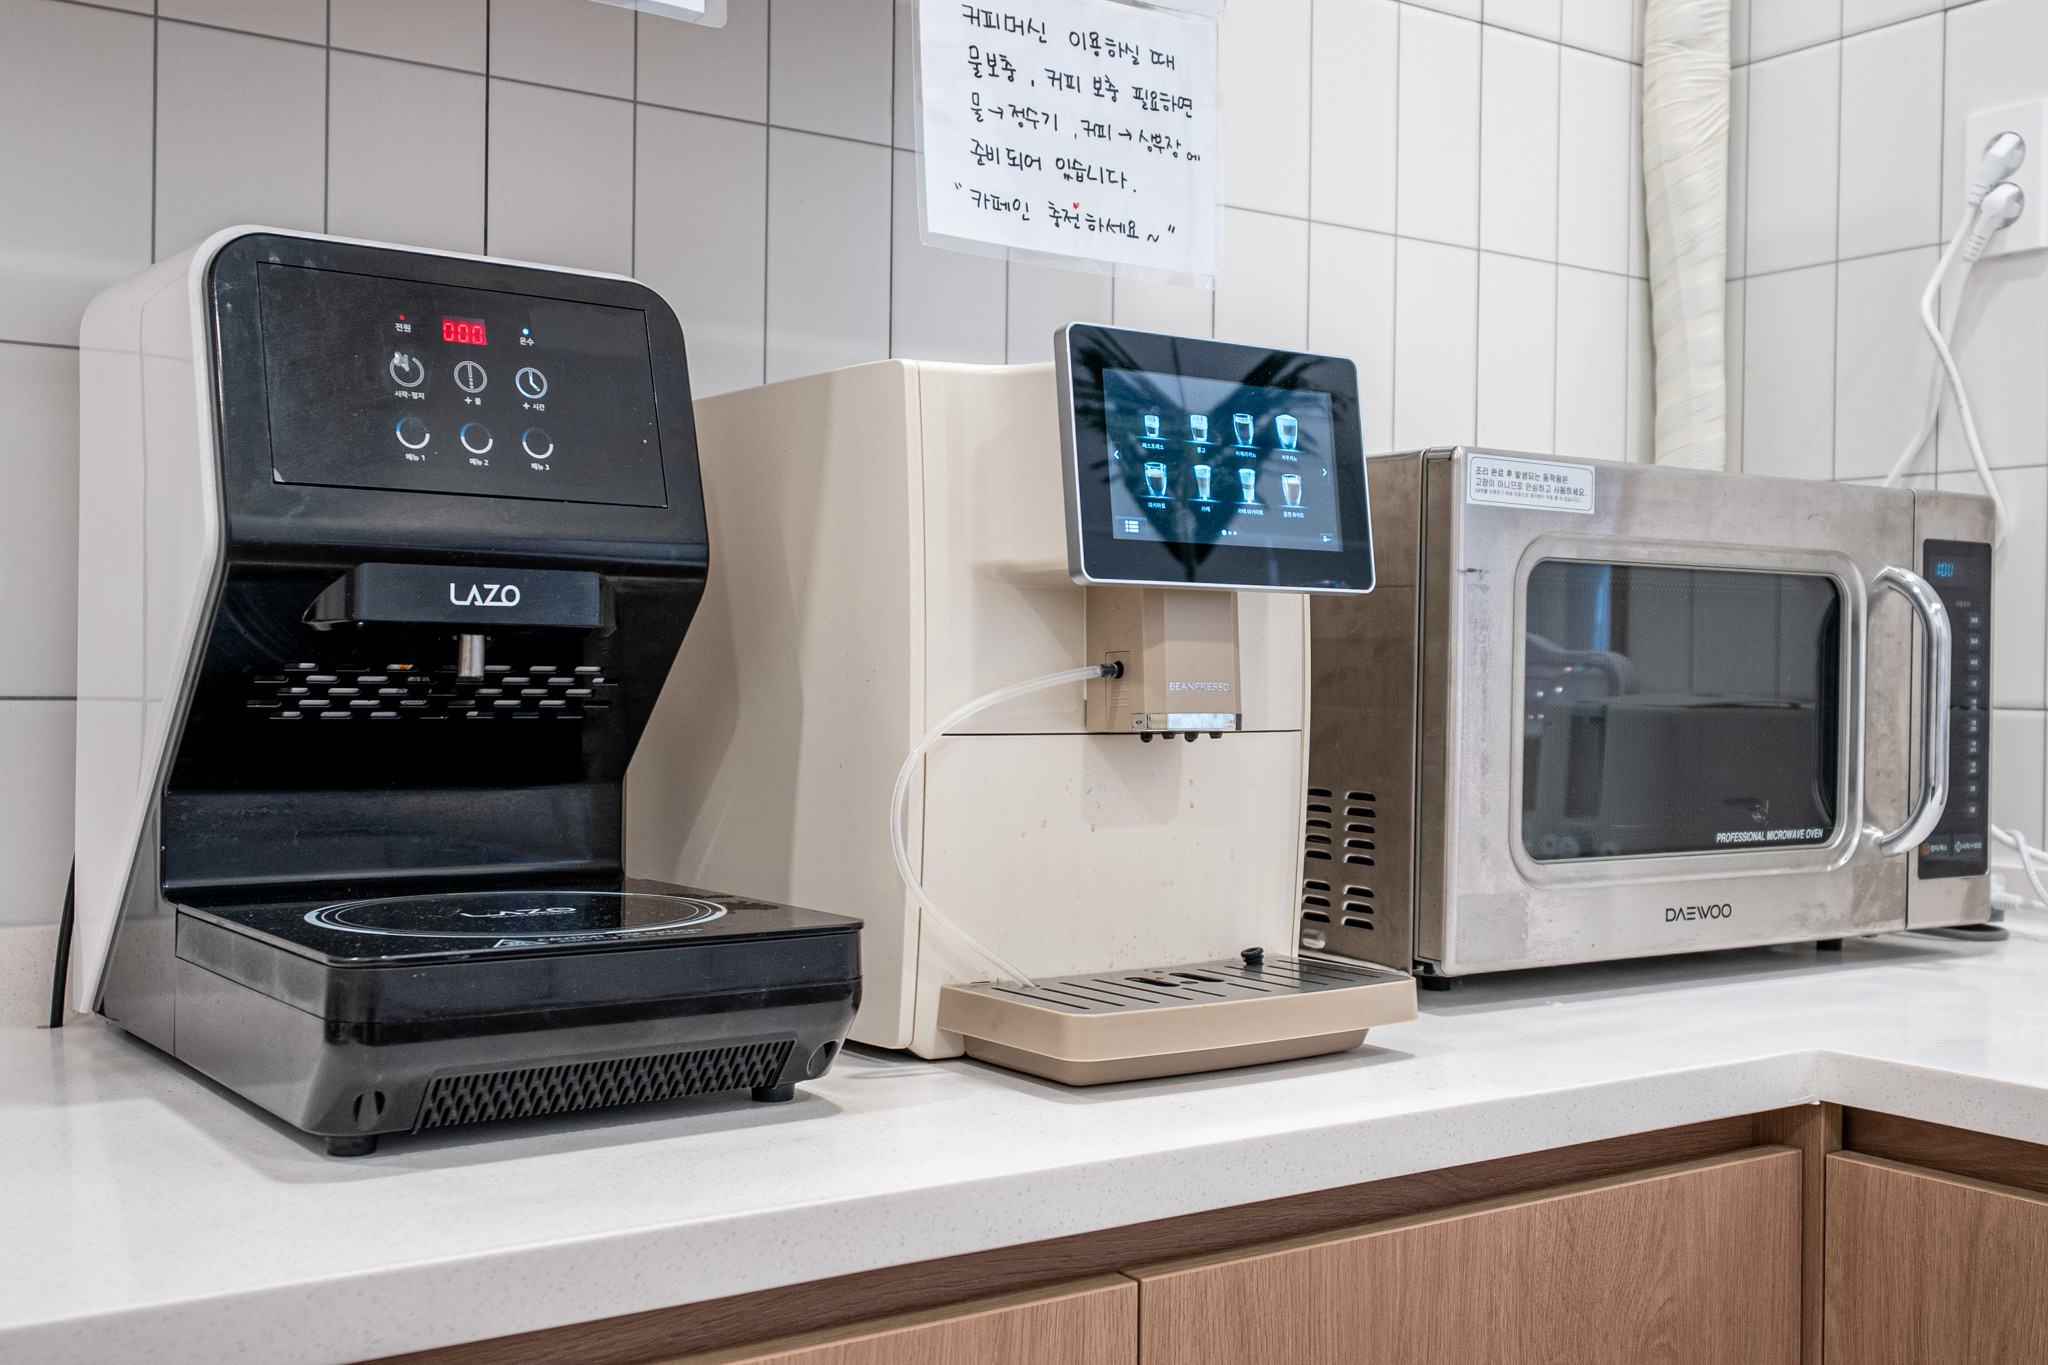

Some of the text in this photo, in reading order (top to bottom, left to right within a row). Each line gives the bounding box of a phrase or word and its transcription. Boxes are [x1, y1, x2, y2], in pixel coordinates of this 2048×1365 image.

[961, 4, 1175, 70] 커피머신 이용하실 때
[1044, 68, 1081, 93] 커피
[1093, 74, 1119, 102] 보충
[1131, 86, 1193, 118] 필요하면
[394, 322, 412, 333] 전원
[442, 321, 486, 345] 000
[519, 336, 535, 347] 온수
[532, 403, 545, 411] 시간
[405, 453, 419, 461] 메뉴
[469, 458, 482, 466] 메뉴
[530, 462, 550, 471] 메뉴 3
[1475, 466, 1489, 476] 조리
[1491, 468, 1504, 477] 완료
[1506, 469, 1513, 478] 후
[1515, 470, 1541, 482] 발생되는
[1475, 477, 1587, 496] 고장이 아니므로 안심하고 사용하세요.
[449, 582, 521, 607] LAZO
[1168, 681, 1231, 692] BEANPRESSO
[1716, 827, 1824, 844] PROFESSIONAL MICROWAVE OVEN
[1665, 903, 1732, 922] DAEWOO
